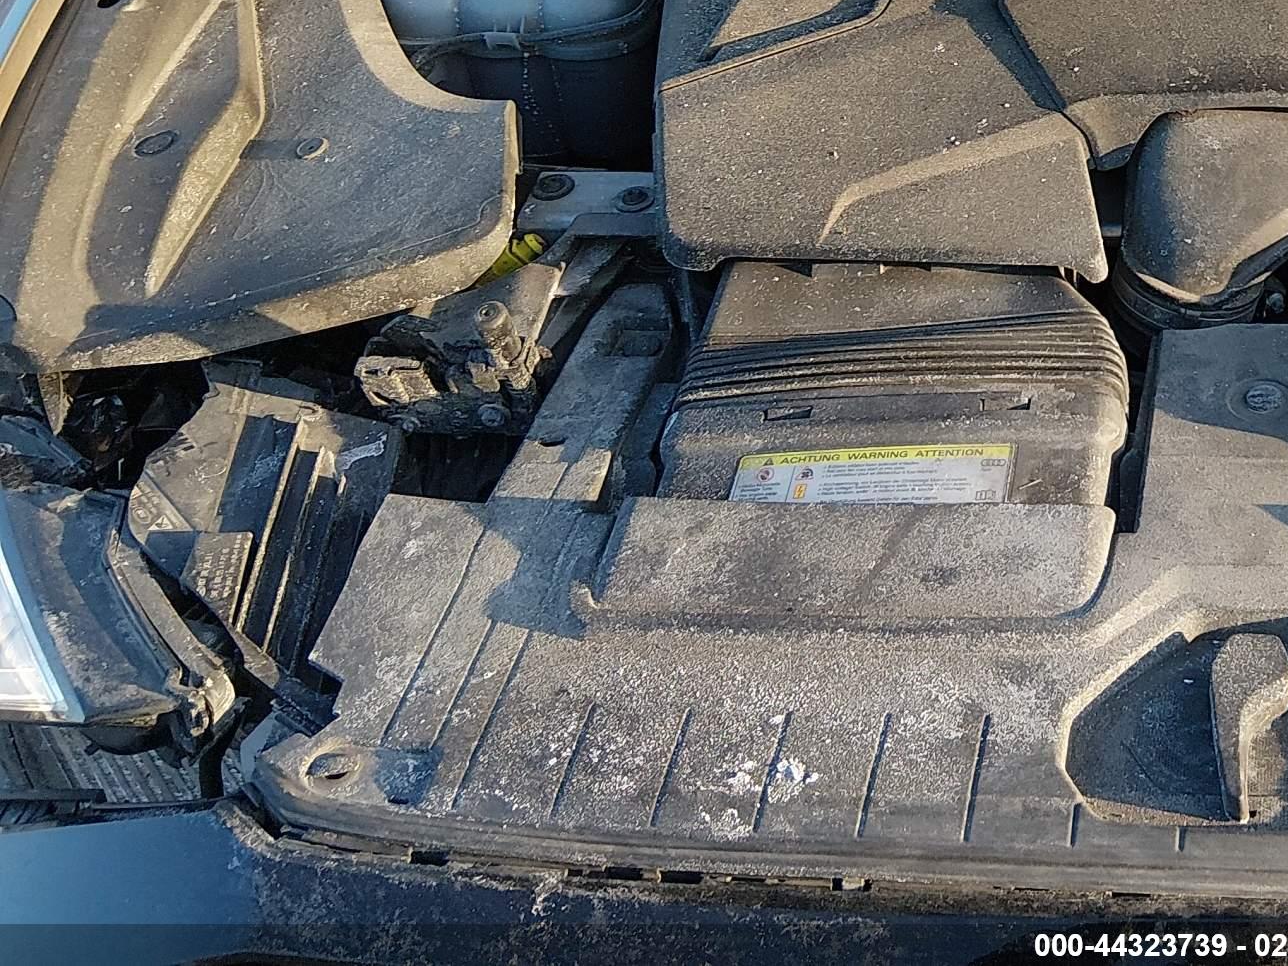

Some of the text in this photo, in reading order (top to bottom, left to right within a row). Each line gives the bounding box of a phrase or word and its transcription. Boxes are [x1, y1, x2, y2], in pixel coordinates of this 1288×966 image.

[780, 448, 984, 465] ACHTUNG WARNING ATTENTION
